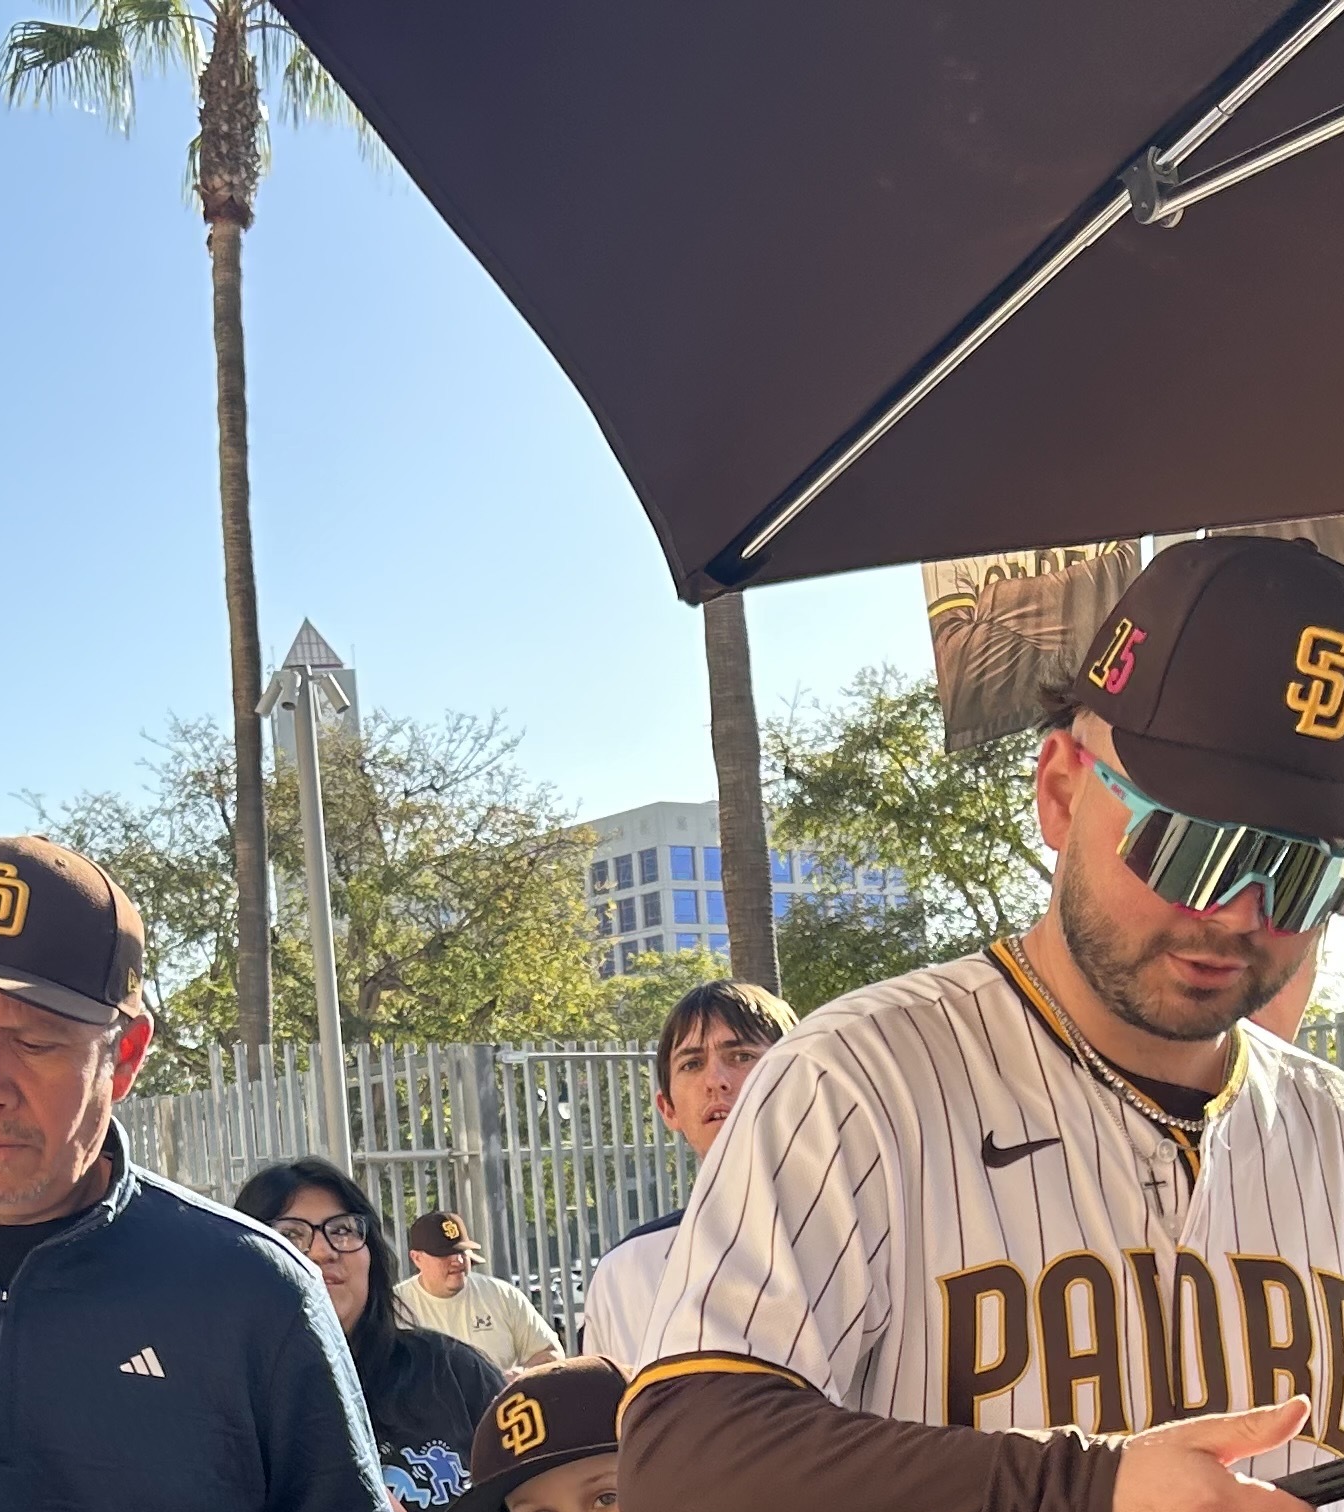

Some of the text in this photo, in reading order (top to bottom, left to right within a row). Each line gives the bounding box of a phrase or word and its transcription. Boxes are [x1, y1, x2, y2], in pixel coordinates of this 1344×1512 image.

[1088, 617, 1147, 695] 15
[442, 1219, 460, 1240] SD
[496, 1391, 546, 1456] SD
